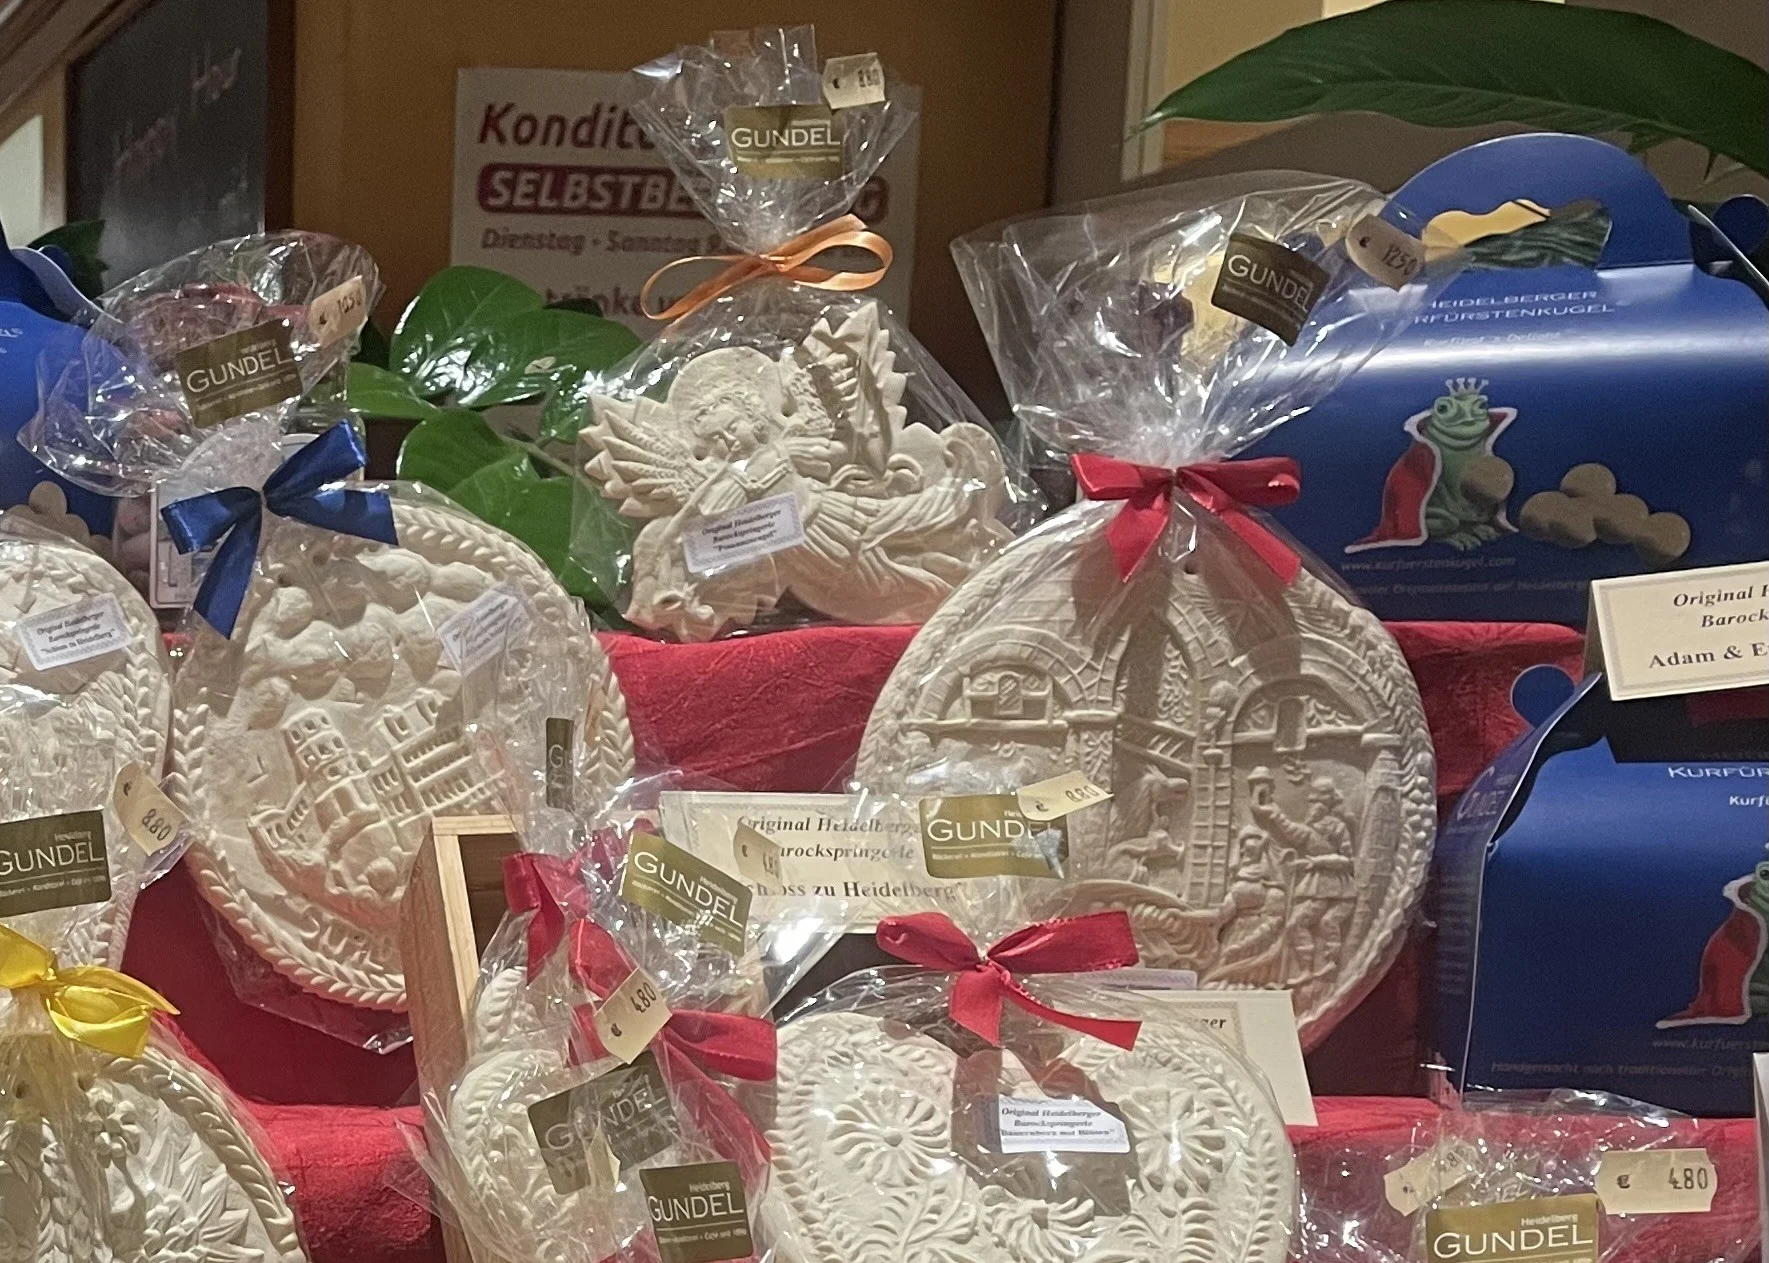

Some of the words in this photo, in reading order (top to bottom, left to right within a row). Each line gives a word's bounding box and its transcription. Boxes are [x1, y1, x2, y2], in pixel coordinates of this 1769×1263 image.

[731, 127, 841, 149] GUNDEL
[1228, 253, 1314, 314] GUNDEL
[186, 347, 293, 393] GUNDEL
[1673, 585, 1754, 607] Original
[1649, 652, 1716, 669] Adam
[1723, 645, 1743, 660] &
[633, 851, 744, 928] GUNDEL
[812, 885, 836, 897] zu
[647, 1191, 745, 1223] GUNDEL
[1521, 1213, 1579, 1227] Heidelberg
[1432, 1224, 1594, 1260] GUNDEL
